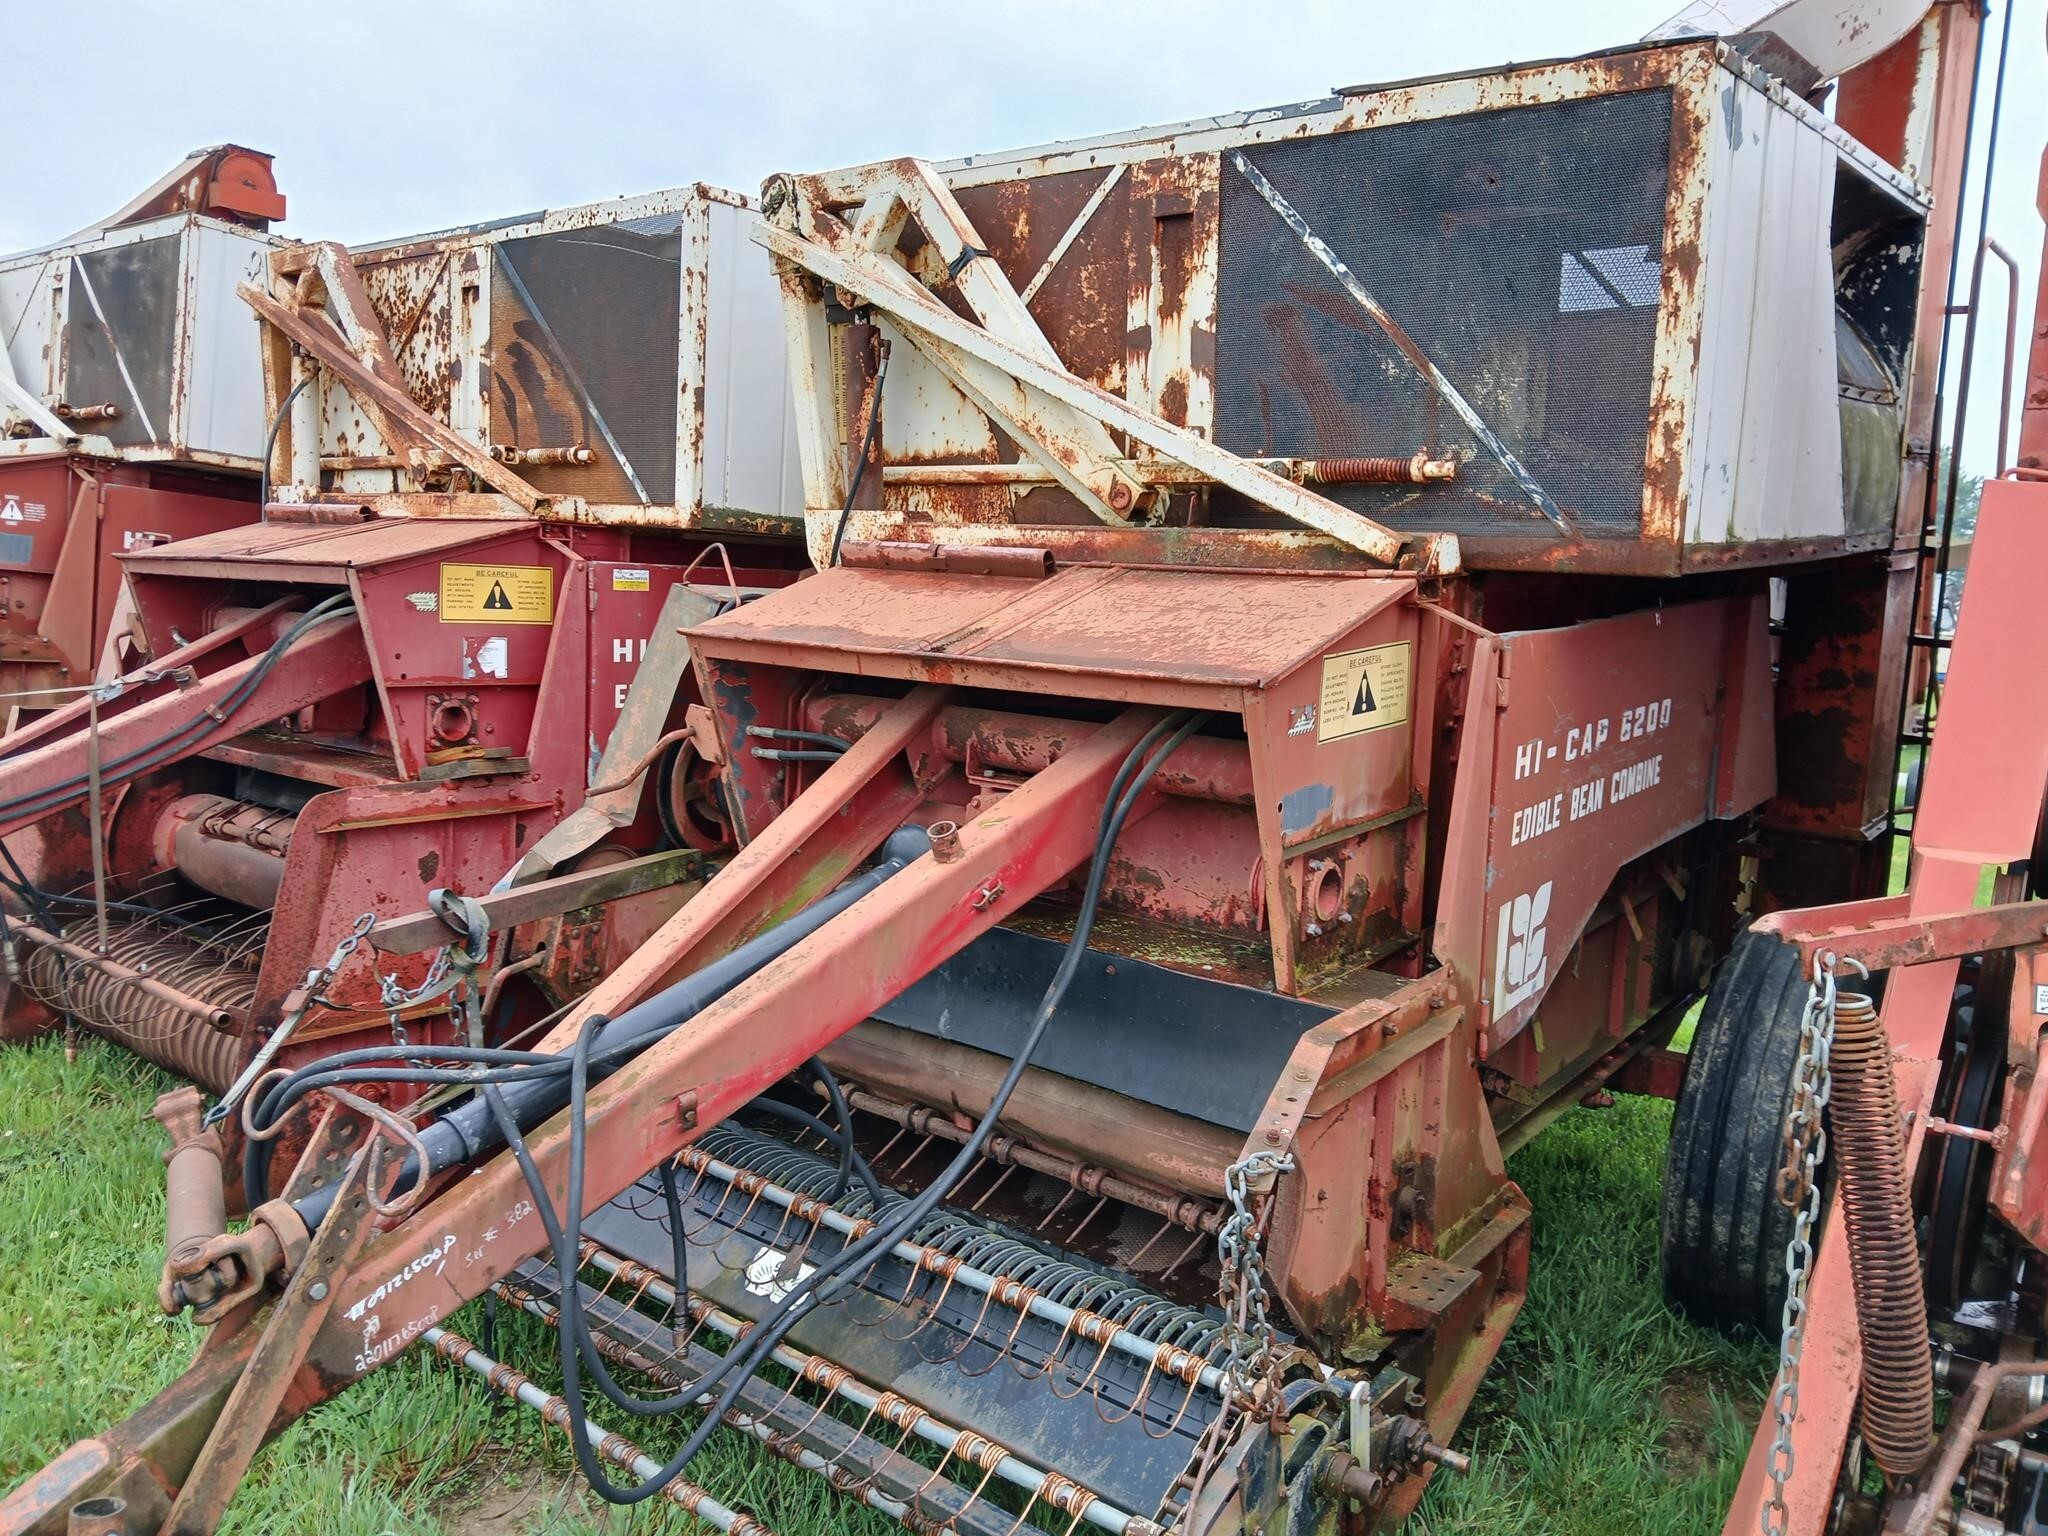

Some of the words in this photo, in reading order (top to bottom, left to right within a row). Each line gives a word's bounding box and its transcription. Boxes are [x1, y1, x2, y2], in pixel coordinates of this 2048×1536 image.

[1620, 698, 1672, 743] 6200
[1511, 793, 1564, 847] EDIBLE
[1569, 778, 1605, 822] BEAN
[1610, 754, 1664, 804] COMBINE
